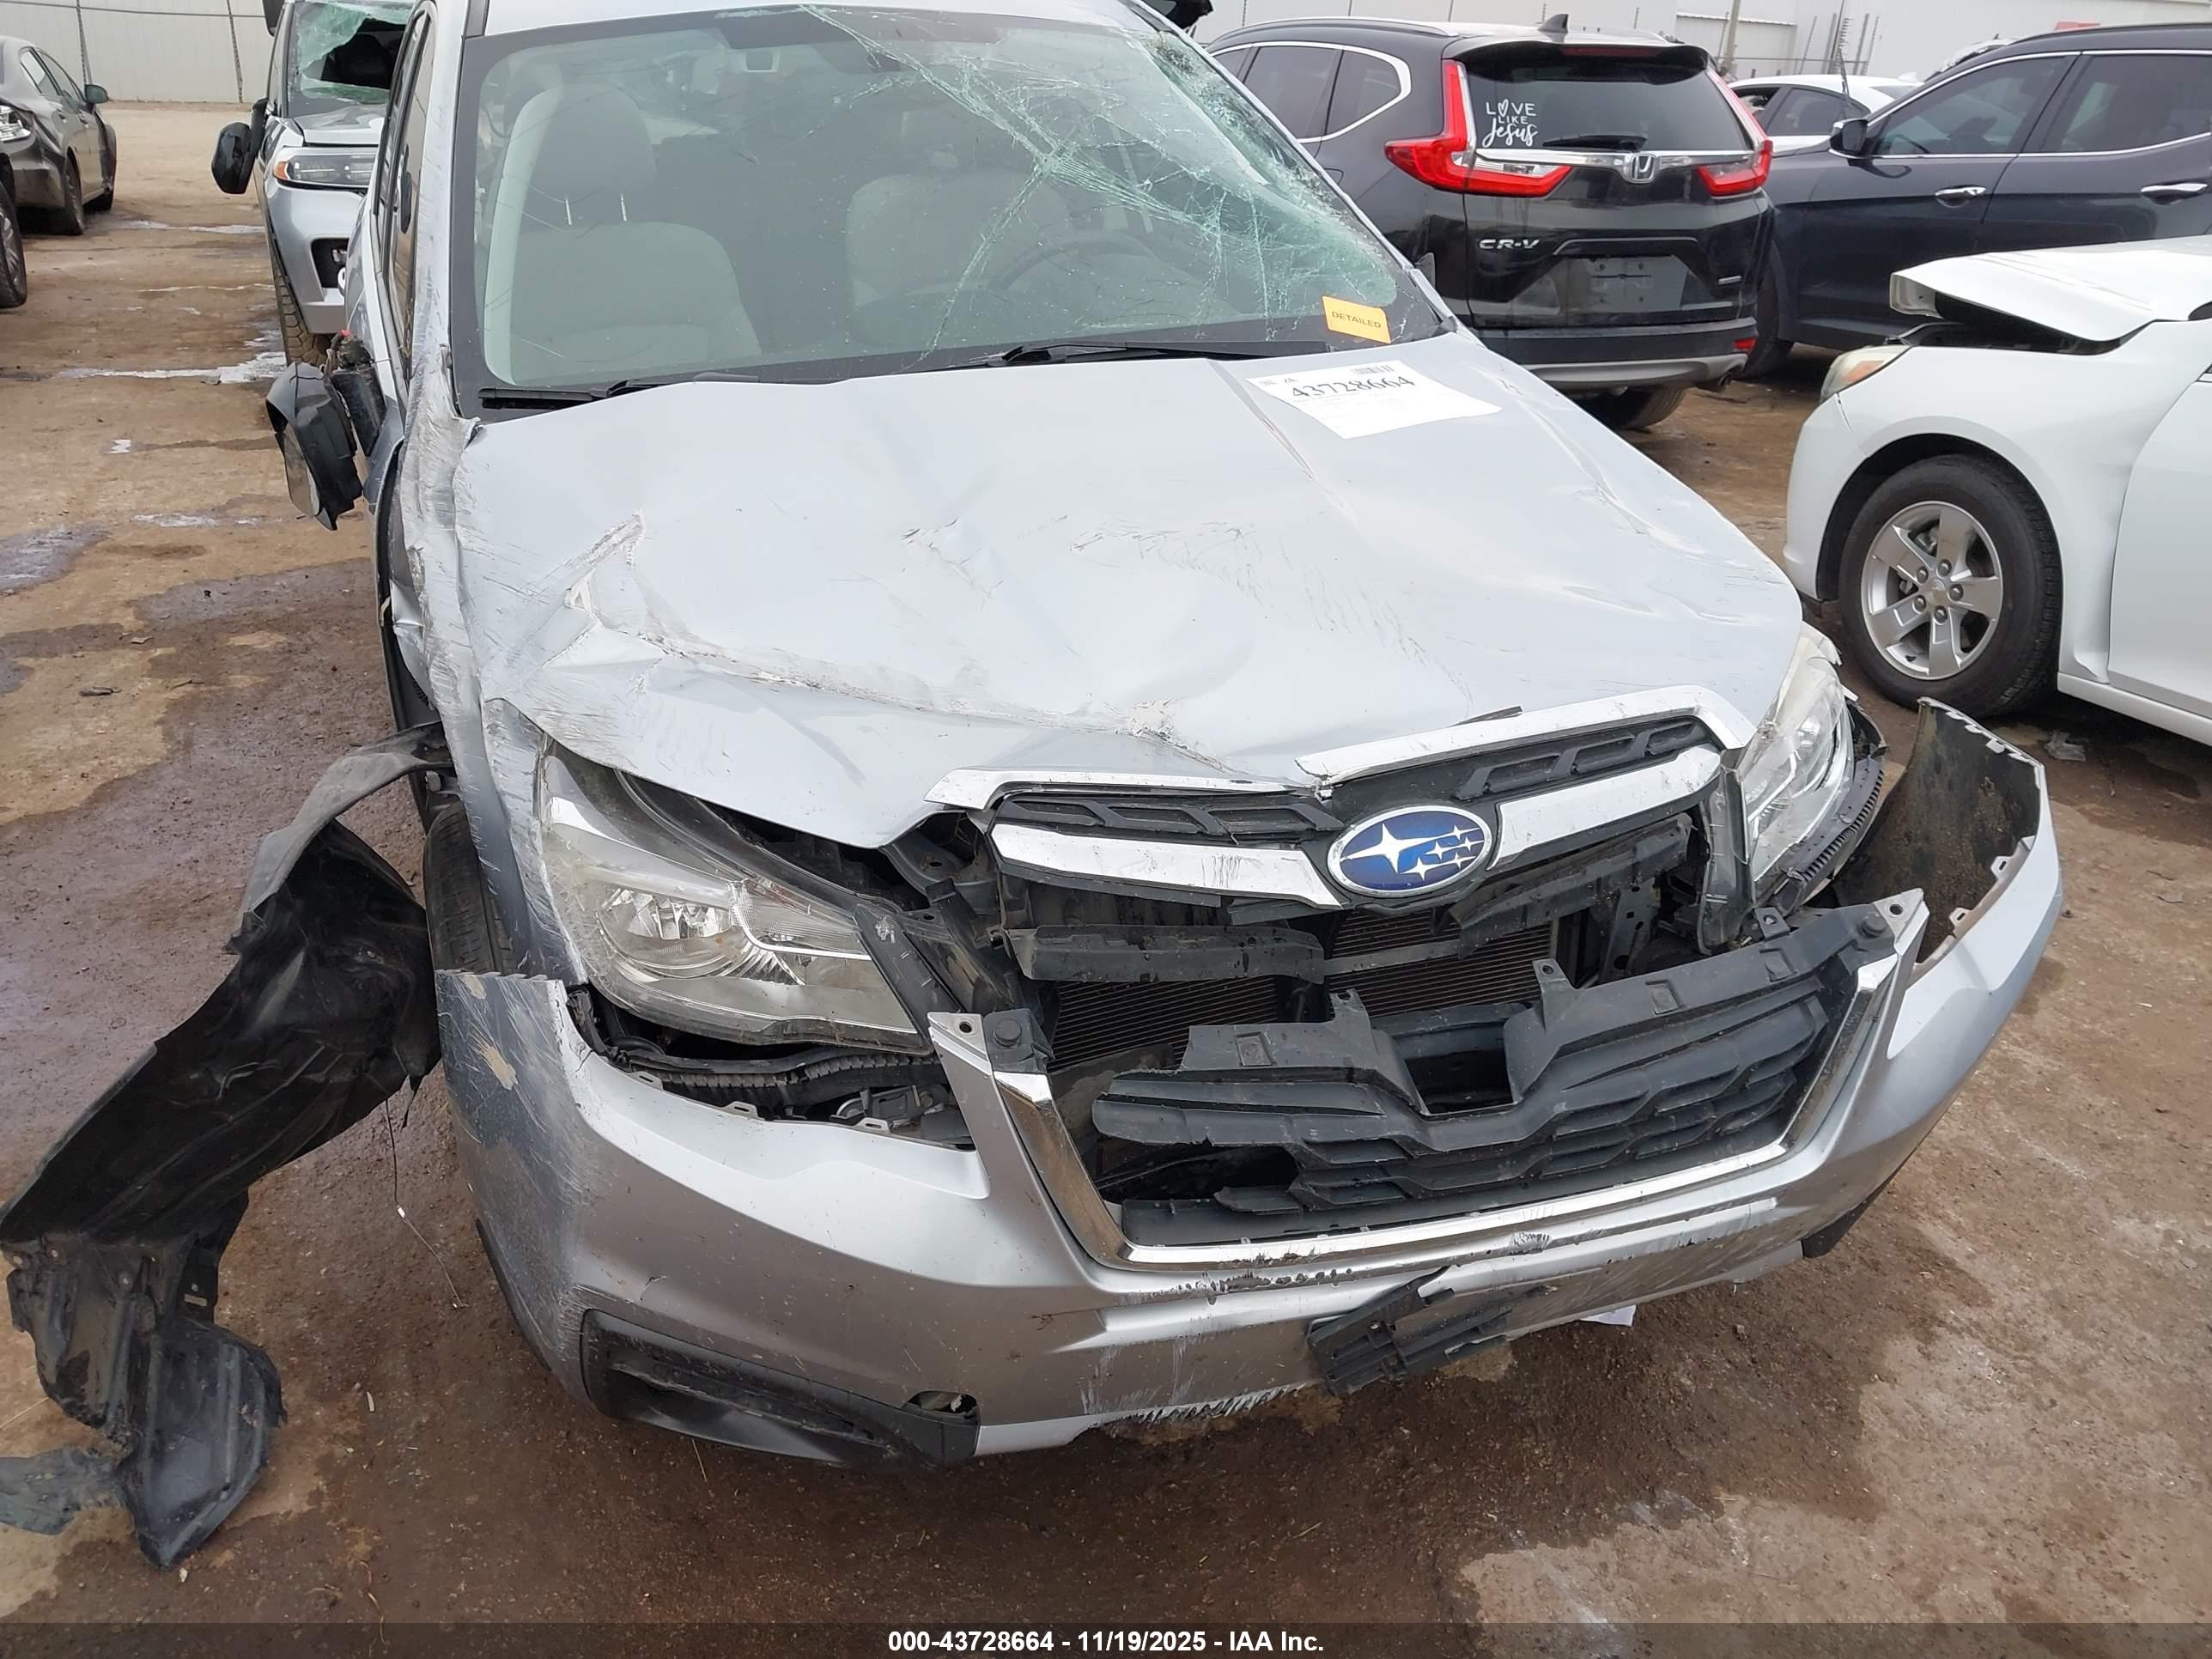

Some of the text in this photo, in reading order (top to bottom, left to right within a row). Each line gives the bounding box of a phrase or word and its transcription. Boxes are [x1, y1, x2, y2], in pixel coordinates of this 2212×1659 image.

[1498, 115, 1528, 125] LIKE
[1482, 118, 1539, 148] Jesus
[1480, 239, 1540, 250] CR-V
[1331, 311, 1382, 329] DETAILED
[1291, 376, 1416, 398] 43728664
